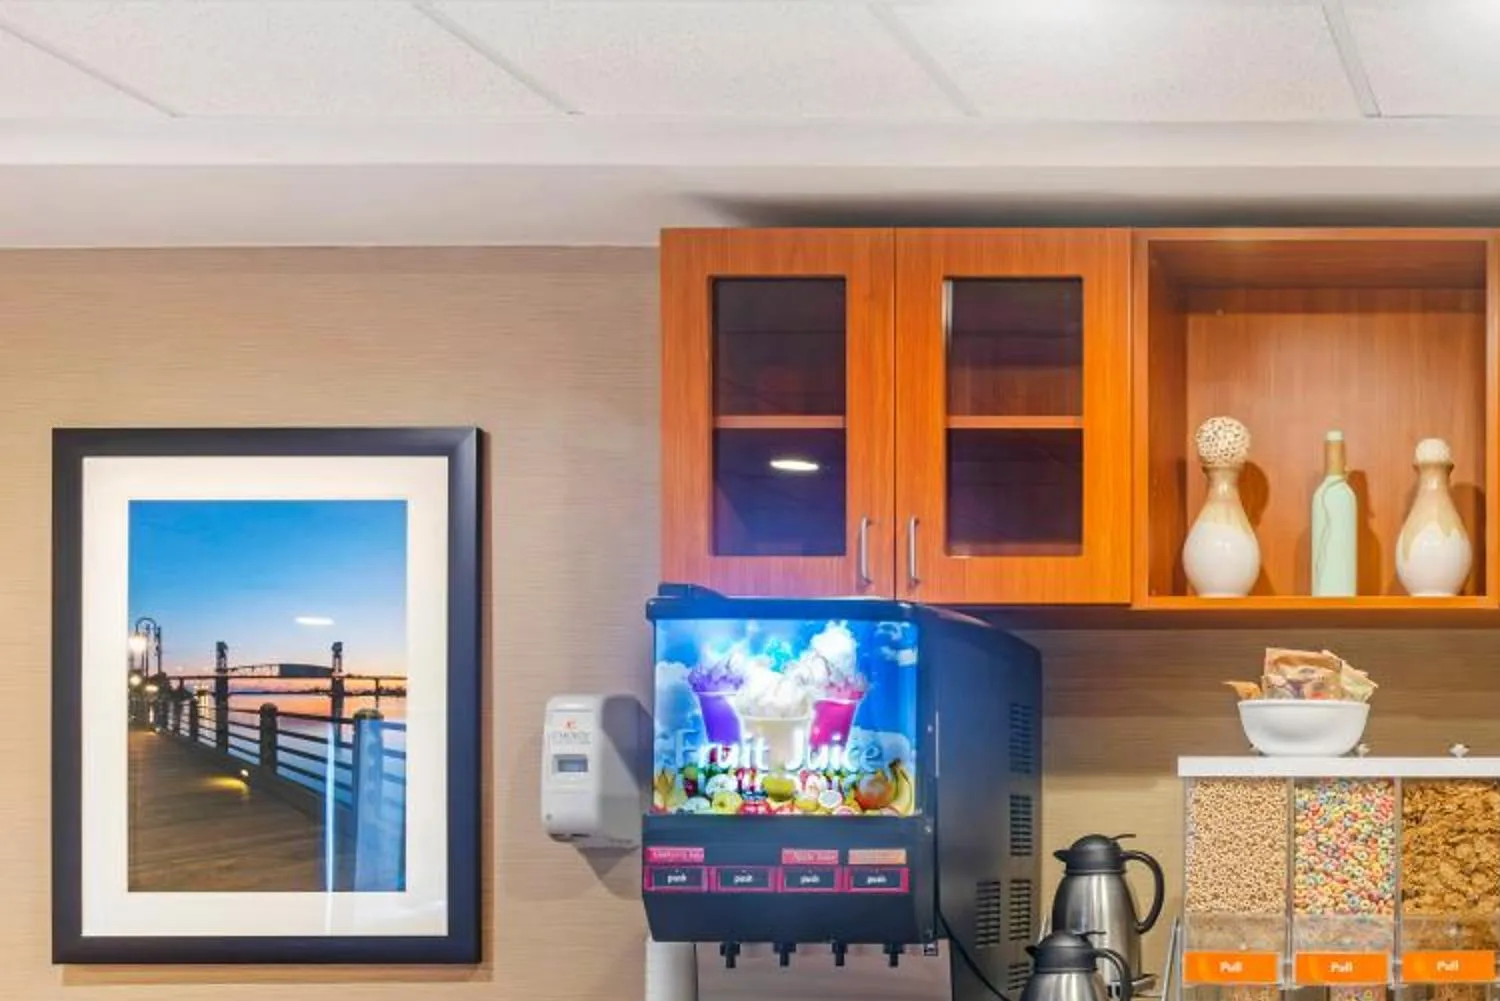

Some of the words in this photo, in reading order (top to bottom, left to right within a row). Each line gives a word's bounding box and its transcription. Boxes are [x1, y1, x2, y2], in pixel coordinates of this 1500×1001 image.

[676, 729, 770, 769] Fruit
[785, 728, 883, 769] Juice
[1219, 960, 1243, 973] Pull
[1330, 961, 1353, 973] Pull
[1436, 959, 1459, 972] Pull
